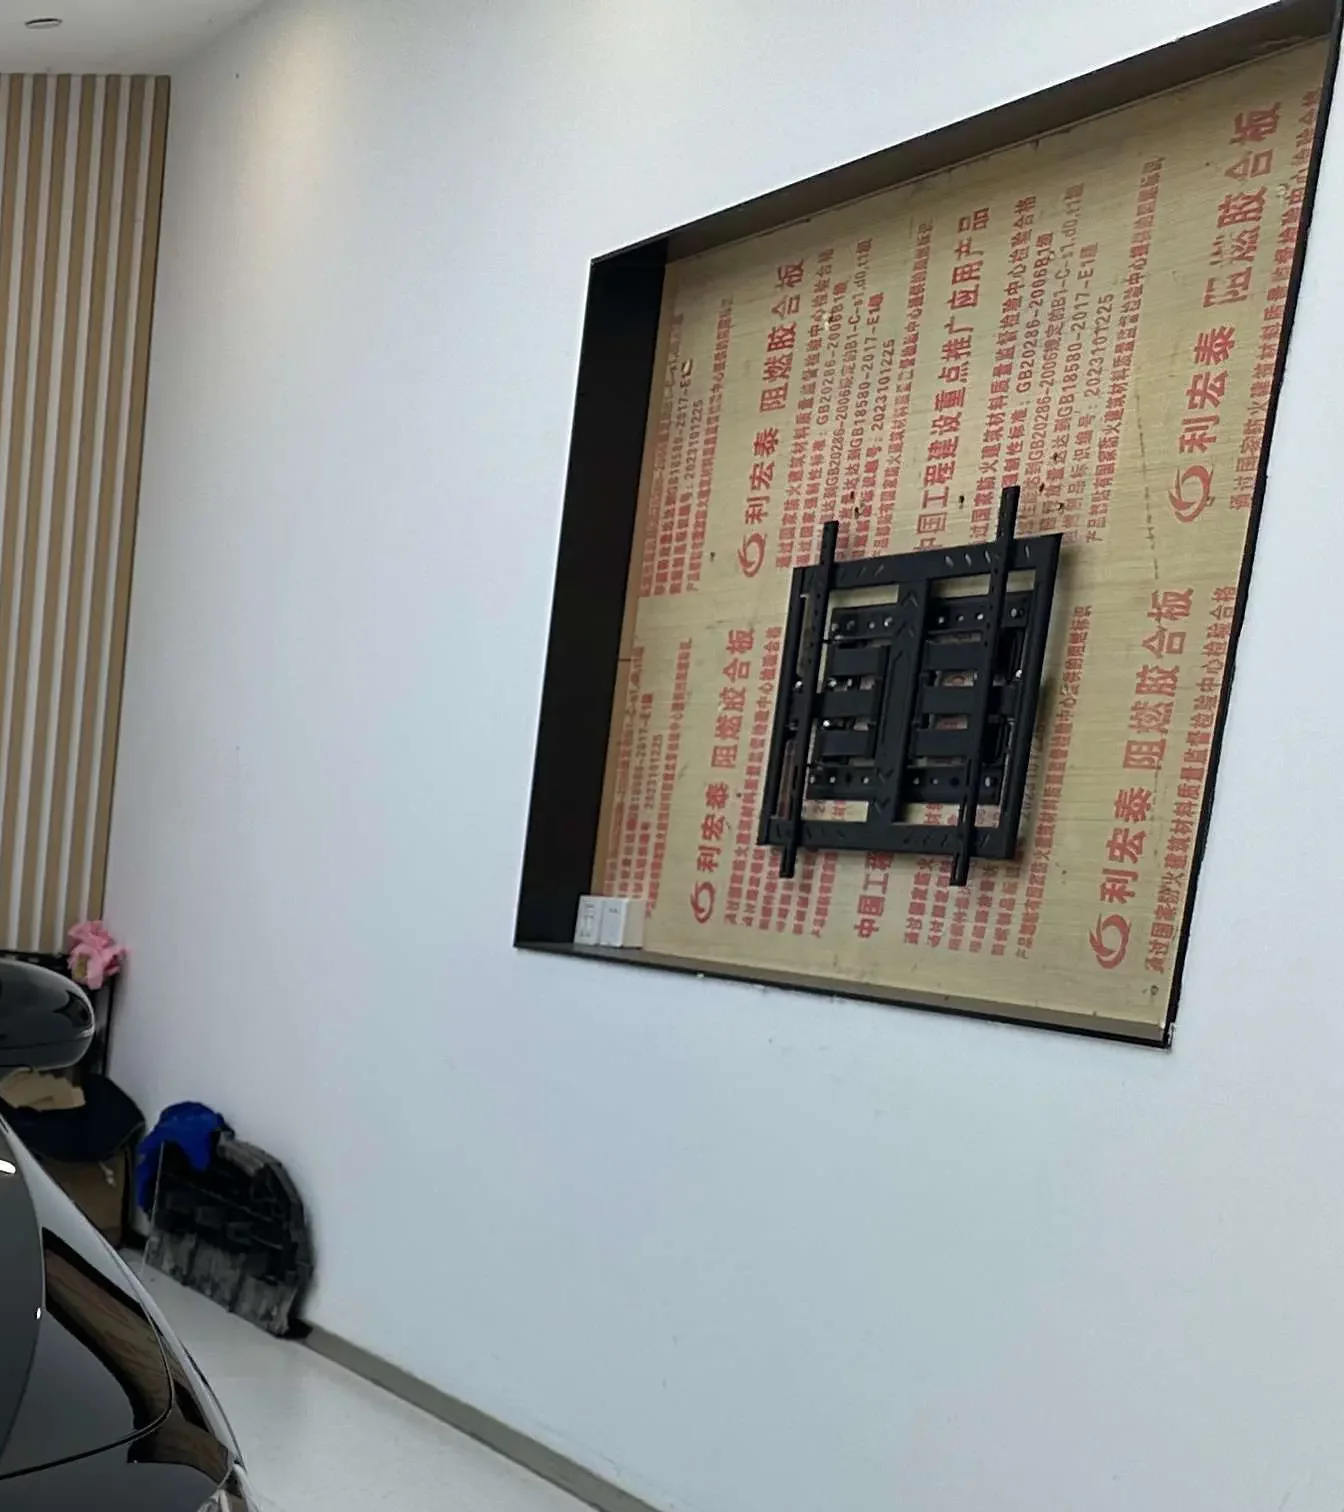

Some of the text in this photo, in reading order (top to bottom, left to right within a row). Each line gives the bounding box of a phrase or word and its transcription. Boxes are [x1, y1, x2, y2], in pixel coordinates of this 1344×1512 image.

[743, 257, 805, 525] 利宏泰 阻燃胶合板
[914, 205, 990, 550] 中国工程建设重点推广应用产品
[967, 193, 1036, 544] 过国家防火建筑材料质量监督检验中心检验合格
[1175, 100, 1281, 456] 利宏泰 阻燃胶合板
[695, 780, 730, 872] 利宏泰
[710, 628, 755, 767] 阻燃胶合板
[1096, 587, 1194, 905] 利宏泰 阻燃胶合板
